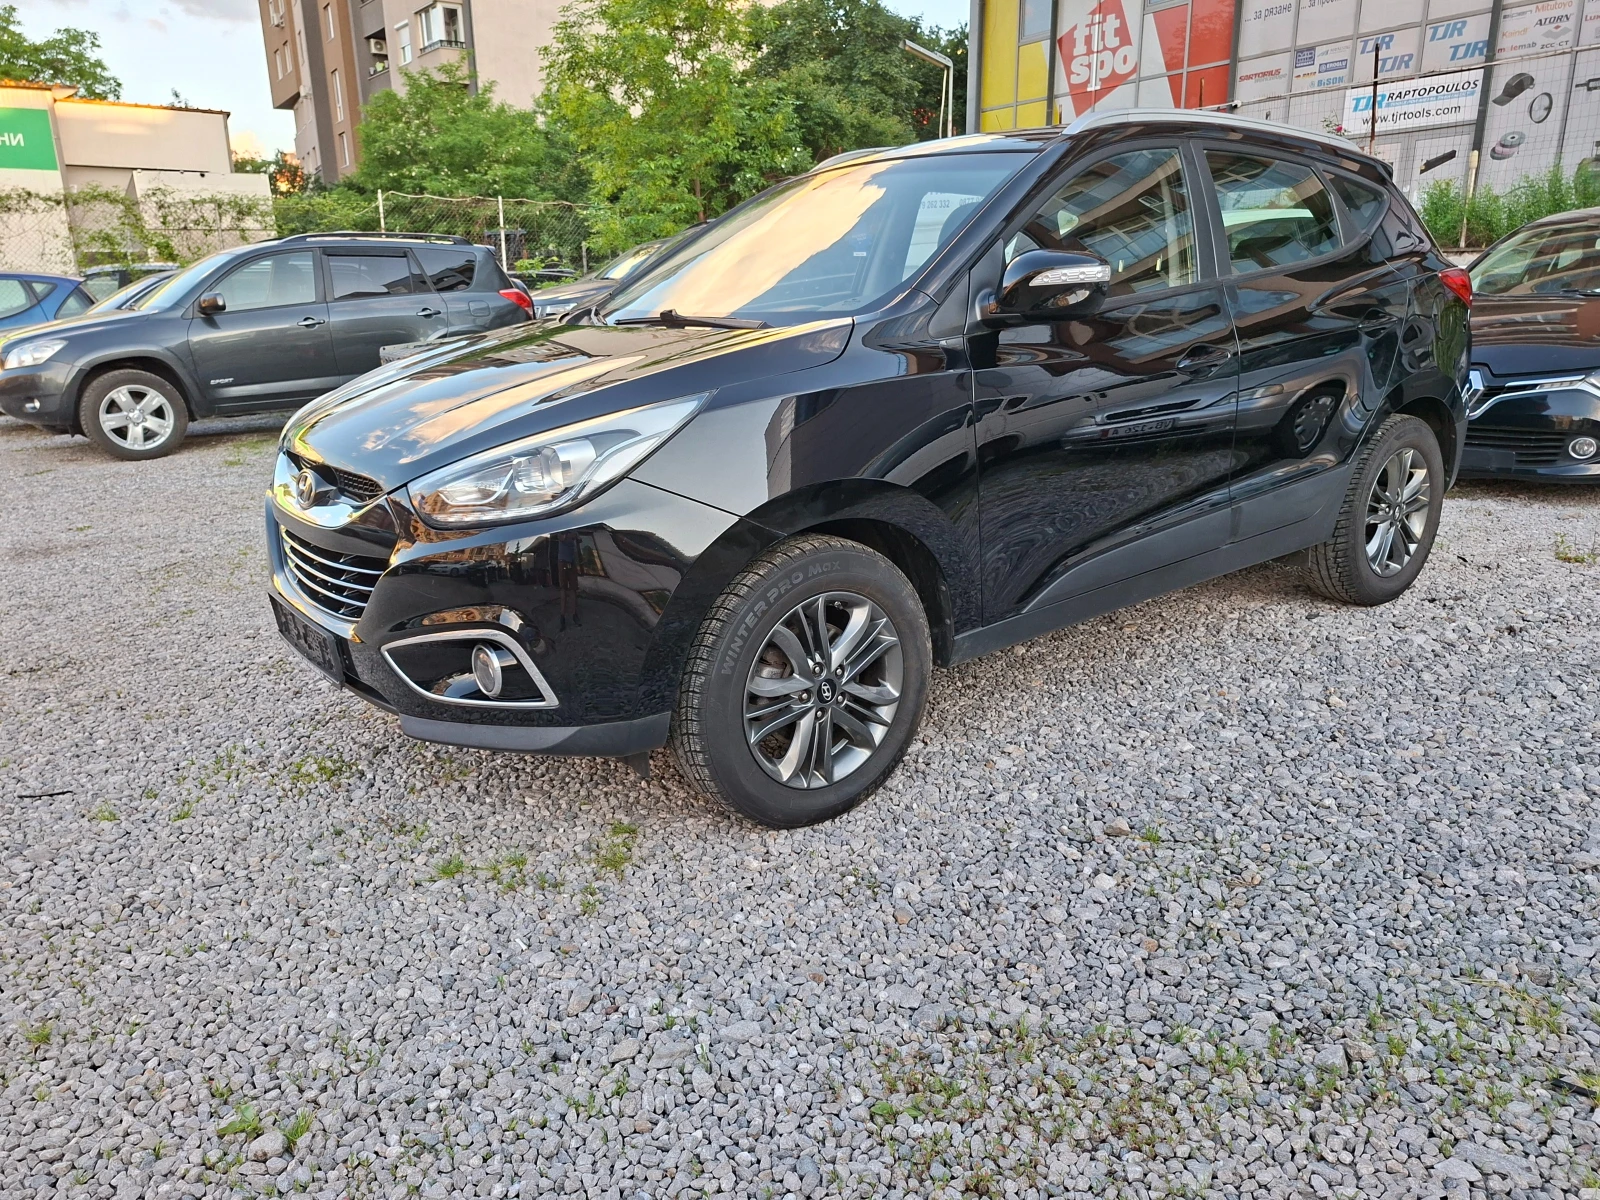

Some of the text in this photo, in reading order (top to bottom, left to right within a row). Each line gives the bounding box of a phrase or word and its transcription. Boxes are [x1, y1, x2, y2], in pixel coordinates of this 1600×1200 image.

[1253, 10, 1263, 20] за
[1264, 3, 1293, 21] рязане
[1535, 1, 1573, 13] Mitutoyo
[1429, 20, 1467, 42] TJR
[1534, 14, 1571, 27] ATORN
[1073, 13, 1120, 56] fit
[1360, 34, 1394, 55] TJR
[1449, 40, 1487, 61] TJR
[1070, 45, 1137, 91] spo
[1379, 53, 1413, 73] TJR
[1352, 91, 1387, 112] TJR
[1387, 80, 1479, 102] RAPTOPOULOS
[721, 601, 768, 676] WINTER
[766, 572, 804, 604] PRO
